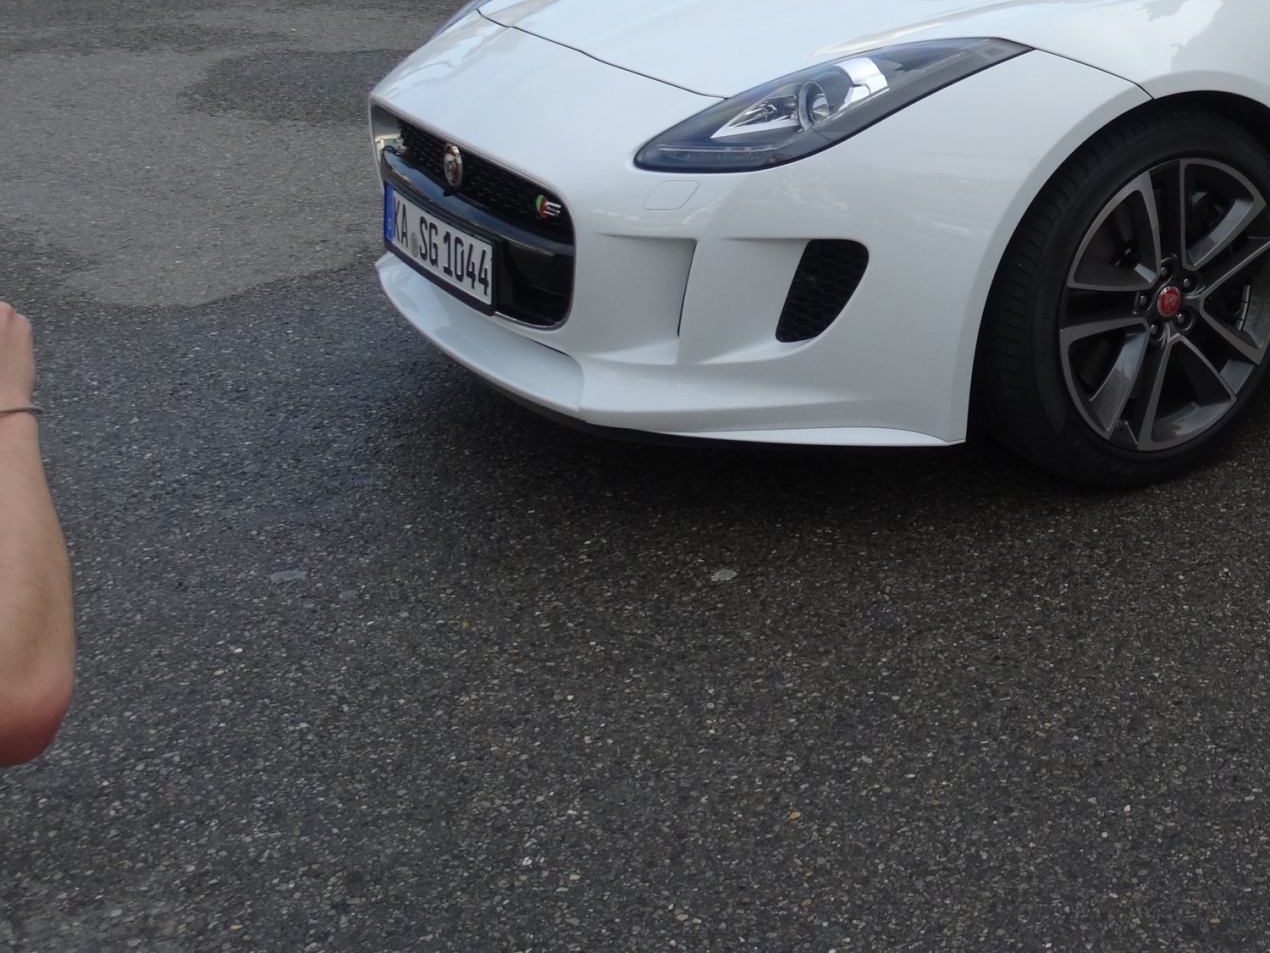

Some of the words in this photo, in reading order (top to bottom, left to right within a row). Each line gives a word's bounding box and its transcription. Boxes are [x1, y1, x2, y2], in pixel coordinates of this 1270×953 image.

[393, 196, 408, 248] KA
[420, 216, 439, 268] SG
[443, 230, 490, 296] 1044
